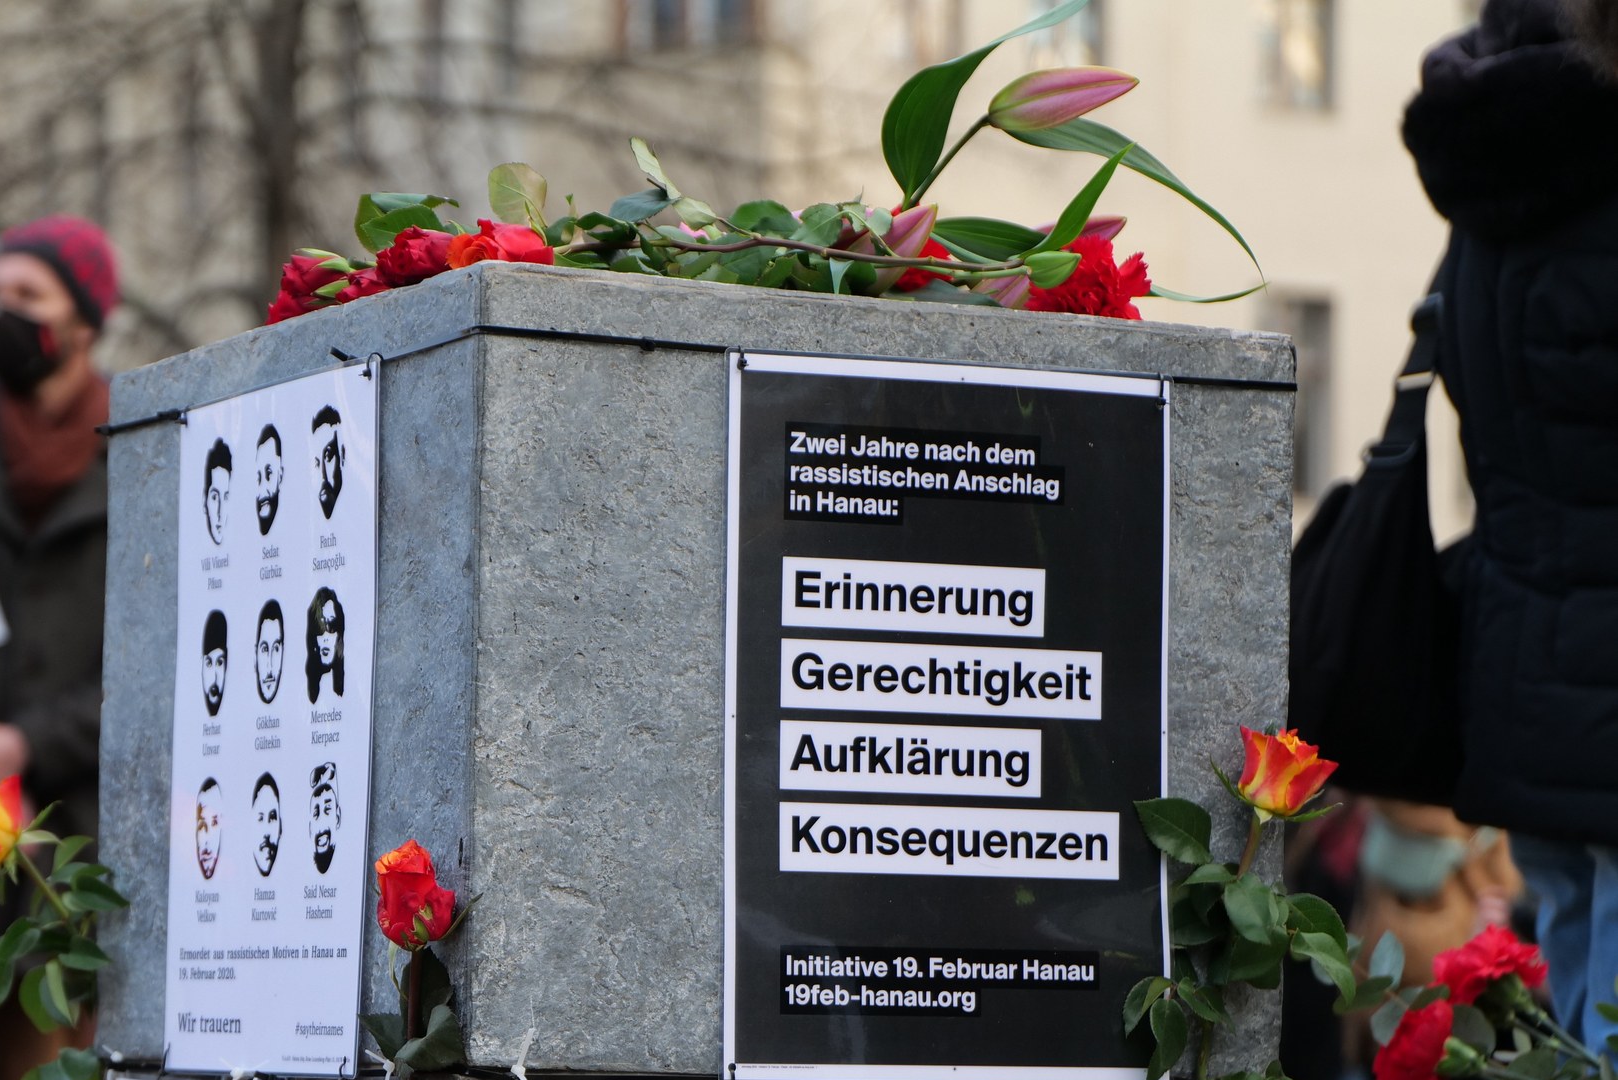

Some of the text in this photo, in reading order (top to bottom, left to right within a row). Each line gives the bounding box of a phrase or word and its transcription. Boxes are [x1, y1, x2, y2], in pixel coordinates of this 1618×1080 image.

[790, 432, 1035, 465] Zwei Jahre nach dem
[790, 464, 1059, 500] rassistischen Anschlag
[790, 492, 898, 515] in Hanau:
[320, 533, 336, 548] Fatih
[262, 545, 279, 559] Sedat
[201, 554, 229, 571] Vili Viorel
[313, 553, 345, 572] Saraçoğlu
[260, 566, 282, 580] Gürbüz
[795, 571, 1034, 626] Erinnerung
[792, 652, 1091, 706] Gerechtigkeit
[256, 717, 279, 729] Gökhan
[311, 708, 342, 724] Mercedes
[203, 723, 221, 736] Ferhat
[255, 736, 280, 750] Gültekin
[311, 731, 339, 746] Kierpacz
[203, 744, 220, 756] Unvar
[790, 734, 1030, 787] Aufklärung
[791, 816, 1109, 865] Konsequenzen
[195, 889, 219, 906] Kaloyan
[254, 888, 275, 900] Hamza
[304, 885, 337, 899] Said Nesar
[197, 909, 216, 922] Velkov
[252, 907, 277, 921] Kurtović
[306, 905, 332, 919] Hashemi
[180, 946, 347, 960] Ermordet aus rassistischen Motiven in Hanau am
[179, 967, 235, 979] 19. Februar 2020.
[786, 956, 1094, 981] Initiative 19. Februar Hanau
[785, 985, 976, 1012] 19feb-hanau.org
[178, 1013, 241, 1033] Wir trauern
[295, 1022, 343, 1038] #saytheirnames
